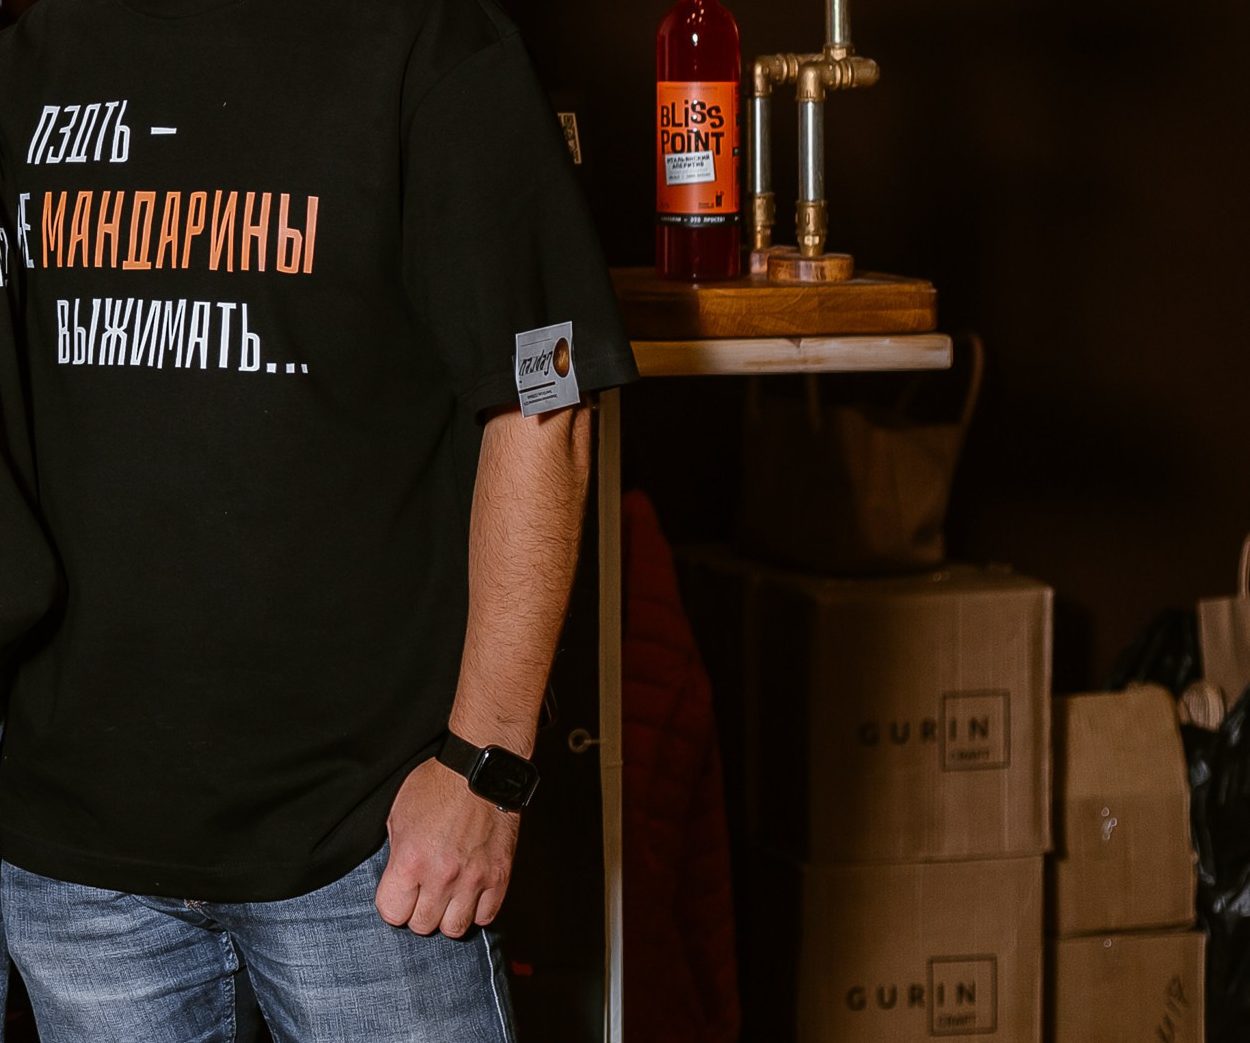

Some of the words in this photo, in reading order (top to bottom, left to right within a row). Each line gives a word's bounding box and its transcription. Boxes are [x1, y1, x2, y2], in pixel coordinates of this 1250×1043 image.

[26, 100, 131, 165] ПЗДТЬ
[41, 190, 319, 274] МАНДАРИНЫ
[859, 714, 990, 747] GURIN
[846, 980, 977, 1012] GURIN
